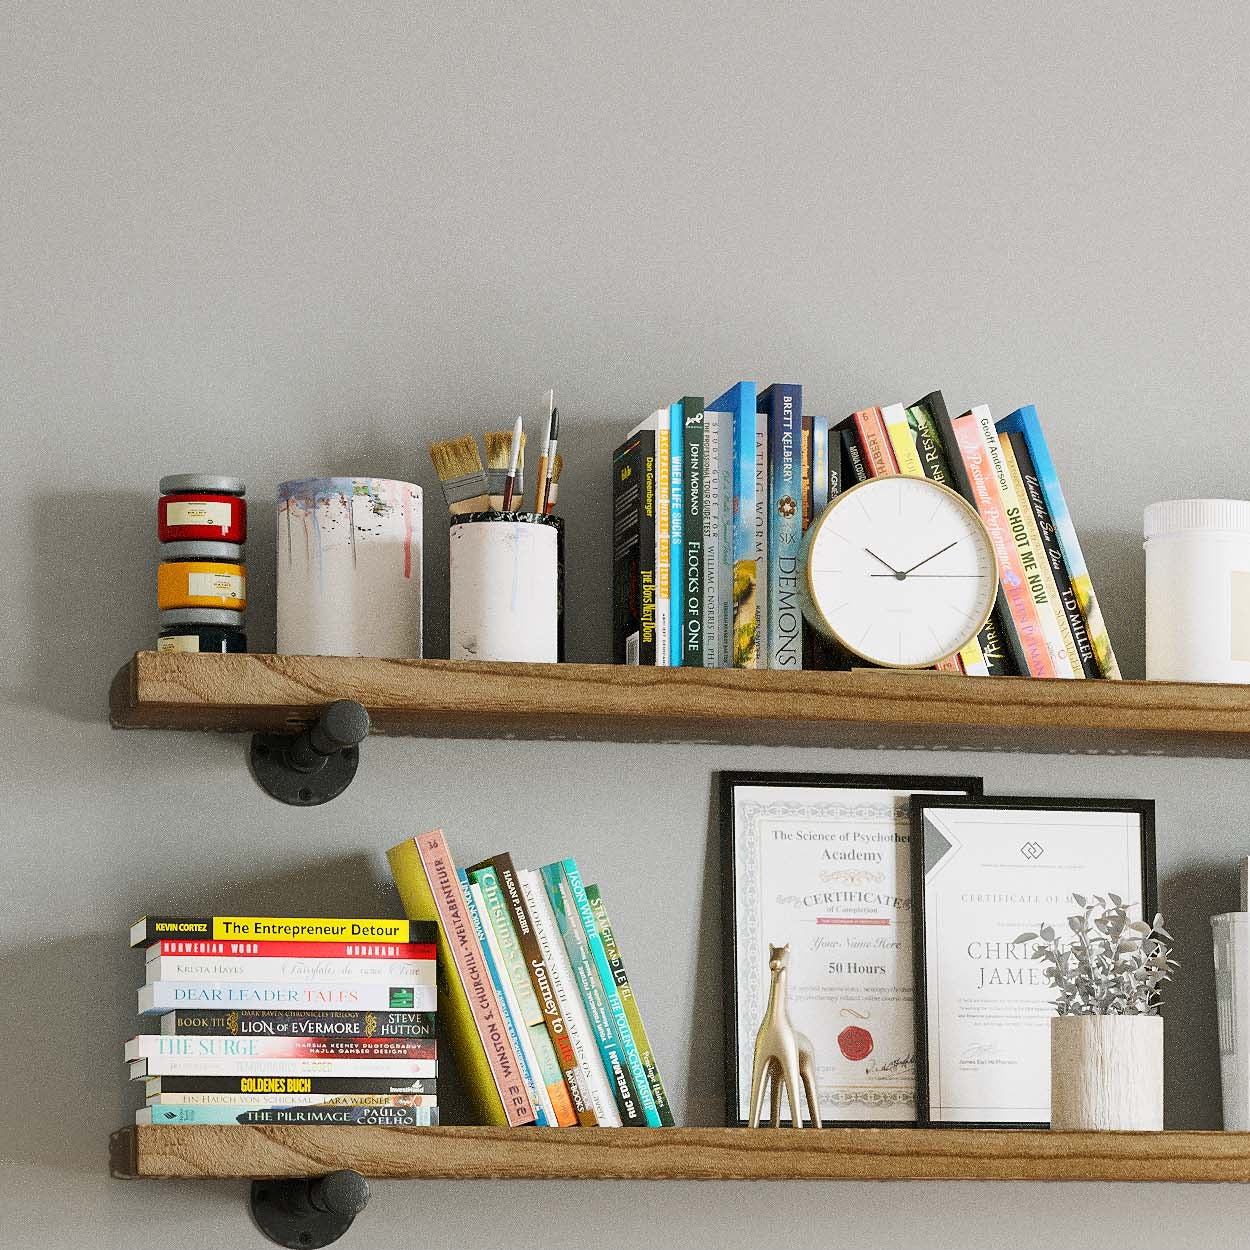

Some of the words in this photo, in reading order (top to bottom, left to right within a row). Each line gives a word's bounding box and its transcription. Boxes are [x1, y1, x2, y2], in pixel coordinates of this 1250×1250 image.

[783, 396, 792, 430] BRETT
[645, 456, 653, 472] Dan
[689, 443, 700, 468] JOHN
[781, 432, 792, 484] KELBERRY
[980, 418, 995, 445] Geoff
[988, 445, 1009, 491] Anderson
[671, 455, 681, 486] WHEN
[644, 472, 653, 518] Greenberger
[671, 488, 681, 508] LIFE
[690, 471, 700, 516] MORANO
[671, 511, 681, 545] SUCKS
[1006, 507, 1030, 548] SHOOT
[688, 541, 700, 593] FLOCKS
[706, 545, 715, 584] WILLIAM
[1020, 551, 1038, 572] ME
[1028, 574, 1049, 605] NOW
[688, 597, 699, 616] OF
[706, 595, 715, 630] NORRIS
[775, 556, 799, 666] DEMONS
[688, 619, 701, 651] ONE
[1069, 613, 1093, 663] MILLER
[772, 830, 793, 841] The
[795, 830, 837, 841] Science
[841, 831, 849, 841] of
[821, 849, 883, 864] Academy
[502, 869, 518, 898] HASAN
[434, 858, 468, 947] WELTABENTEUER
[567, 869, 584, 901] JASON
[580, 900, 598, 940] WHITE
[826, 905, 834, 913] of
[836, 905, 878, 914] Completion
[960, 893, 1041, 905] CERTIFICATE
[155, 922, 178, 932] KEVIN
[178, 922, 208, 932] CORTEZ
[222, 921, 249, 934] The
[253, 921, 347, 938] Entrepreneur
[351, 923, 400, 936] Detour
[482, 872, 518, 961] Christina's
[522, 883, 552, 961] EXPLORATION
[590, 897, 616, 951] STRAIGHT
[163, 942, 224, 954] NORWEGIAN
[230, 943, 259, 954] WOOD
[345, 945, 400, 956] MURAKAMI
[607, 948, 620, 967] AND
[809, 936, 840, 952] Your
[844, 937, 870, 949] Name
[873, 937, 902, 949] Here
[463, 951, 490, 1010] CHURCHILL
[828, 961, 843, 974] 50
[847, 961, 887, 975] Hours
[175, 988, 222, 1001] DEAR
[228, 988, 299, 1001] LEADER
[303, 989, 360, 1002] TALES
[531, 959, 558, 1017] Journey
[613, 968, 633, 1001] LEVEL
[177, 1018, 209, 1027] BOOK
[241, 1020, 276, 1034] LION
[276, 1023, 289, 1032] OF
[291, 1020, 360, 1034] EVERMORE
[380, 1024, 430, 1036] HUTTON
[388, 1013, 421, 1024] STEVE
[551, 1016, 564, 1034] to
[157, 1038, 193, 1055] THE
[199, 1038, 259, 1056] SURGE
[487, 1022, 513, 1079] WINSTON
[555, 1035, 574, 1063] Life
[608, 993, 620, 1012] THE
[614, 1011, 633, 1048] POLLEN
[626, 1048, 655, 1111] SCHOLARSHIP
[608, 1050, 631, 1100] EDELMAN
[641, 1050, 657, 1083] Penelope
[240, 1077, 286, 1093] GOLDENES
[287, 1078, 312, 1093] BUCH
[202, 1095, 236, 1104] HAUCH
[240, 1096, 260, 1104] VON
[263, 1096, 311, 1104] SCHICKSAL
[323, 1097, 349, 1105] LARA
[350, 1097, 391, 1105] WEGNER
[363, 1108, 407, 1117] PAULO
[624, 1100, 637, 1119] RIC
[247, 1112, 273, 1121] THE
[277, 1112, 351, 1122] PILRIMAGE
[357, 1116, 414, 1125] COELHO
